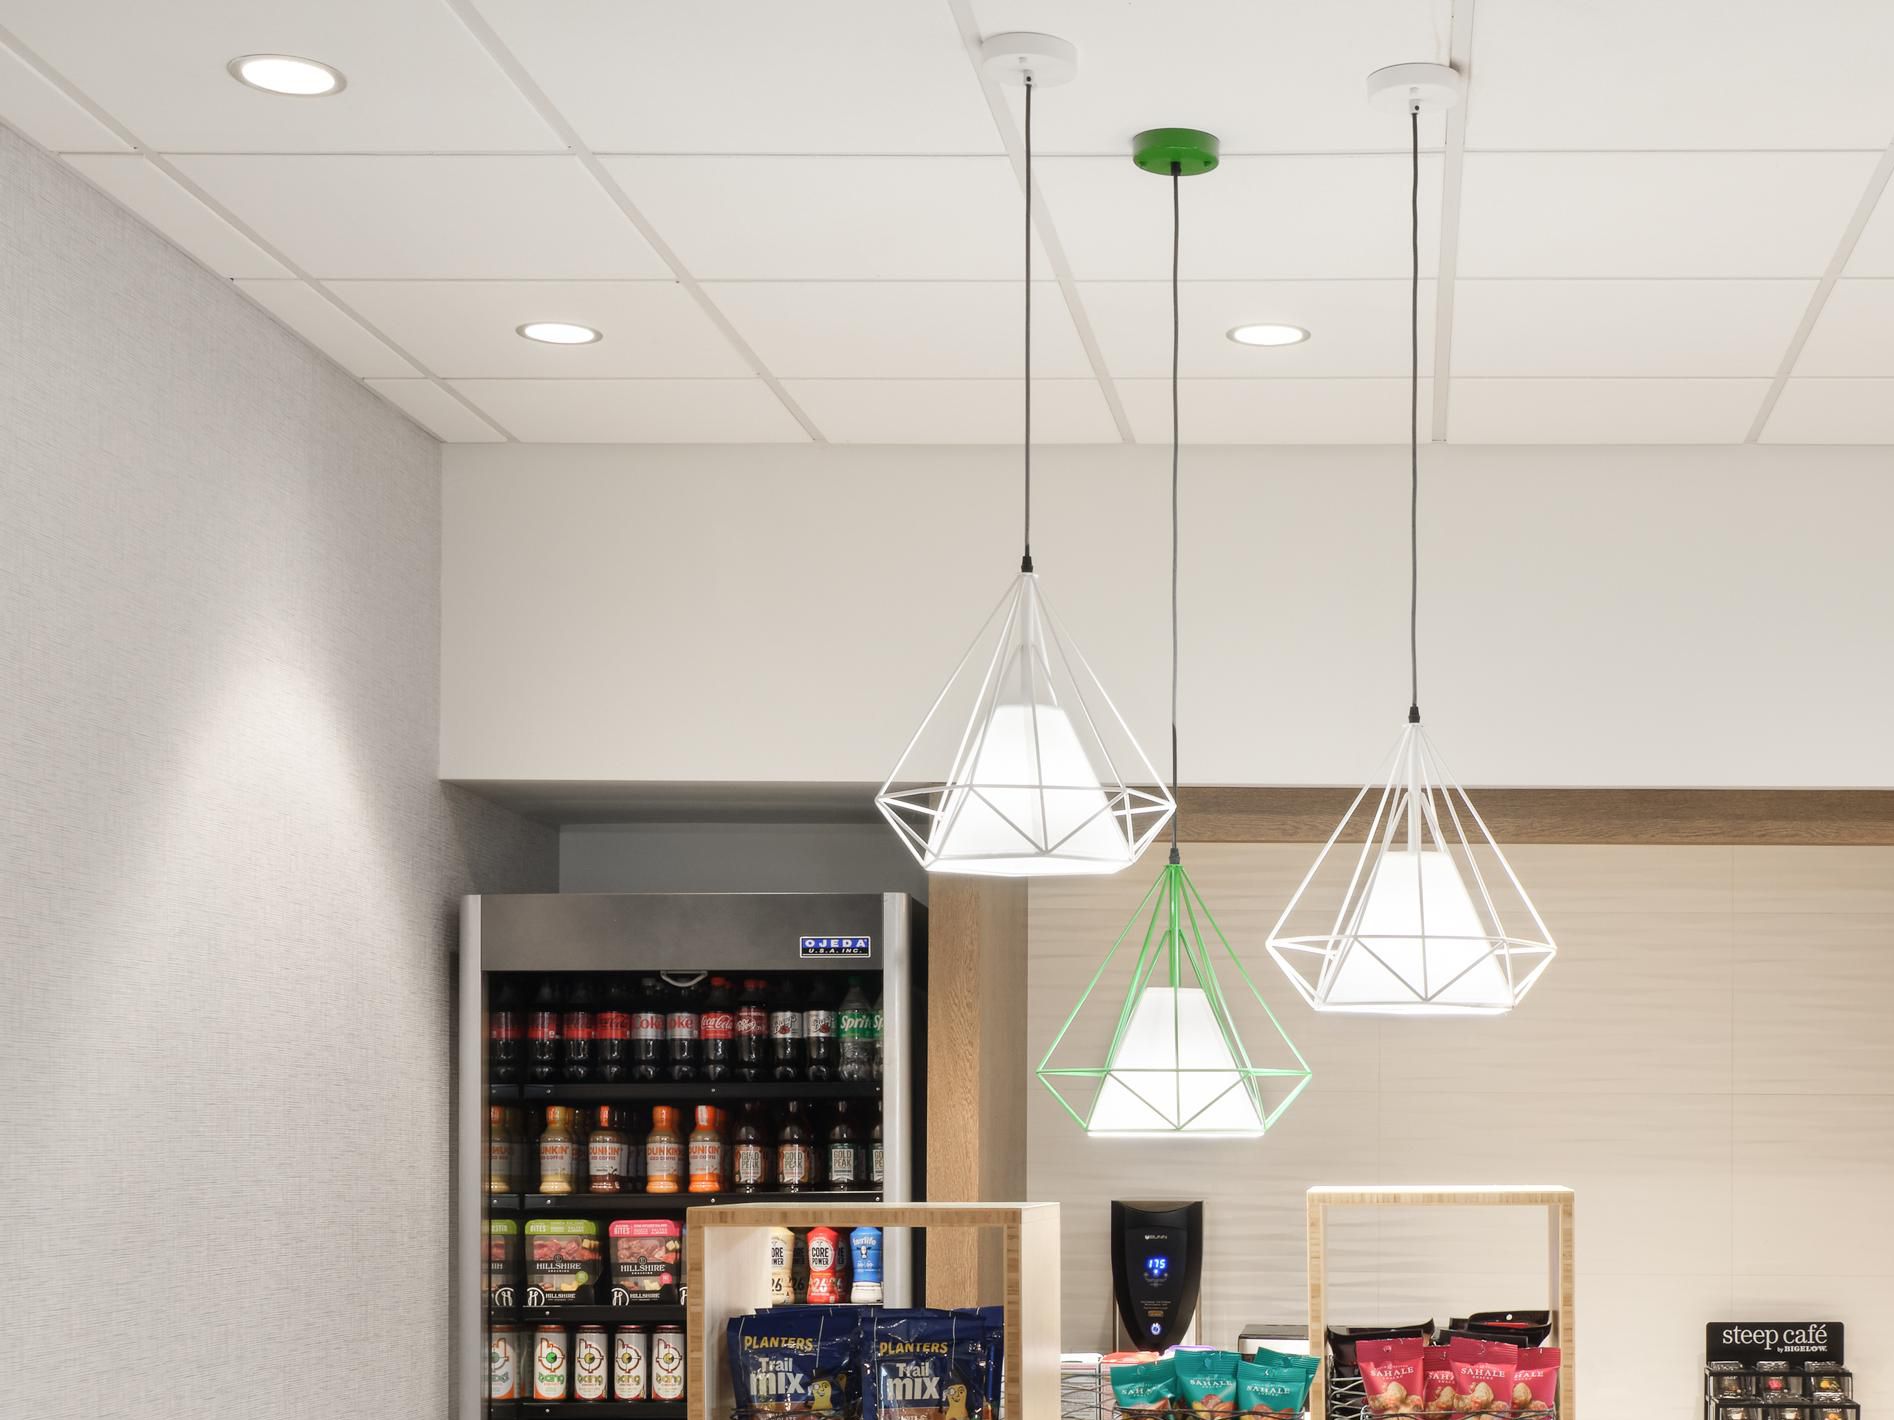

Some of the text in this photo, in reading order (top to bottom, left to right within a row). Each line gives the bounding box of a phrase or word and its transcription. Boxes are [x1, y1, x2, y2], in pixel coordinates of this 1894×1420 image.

[804, 939, 866, 948] OJEDA
[833, 1150, 851, 1159] GOLD
[834, 1160, 851, 1168] PEAK
[811, 1247, 829, 1258] CORE
[536, 1262, 582, 1271] HILLSHIRE
[811, 1257, 829, 1266] POWER
[1148, 1259, 1166, 1269] 175
[620, 1264, 666, 1272] HILLSHIRE
[1722, 1323, 1828, 1351] steep café
[744, 1335, 814, 1351] PLANTERS
[879, 1341, 948, 1356] PLANTERS
[1776, 1346, 1784, 1354] by
[758, 1357, 793, 1372] Trail
[895, 1362, 930, 1377] Trail
[1369, 1366, 1415, 1377] SAHALE
[1461, 1367, 1505, 1378] SAHALE
[751, 1372, 805, 1395] mix
[1189, 1378, 1233, 1387] SAHALE
[886, 1376, 940, 1400] mix
[1246, 1385, 1291, 1394] SAHALE
